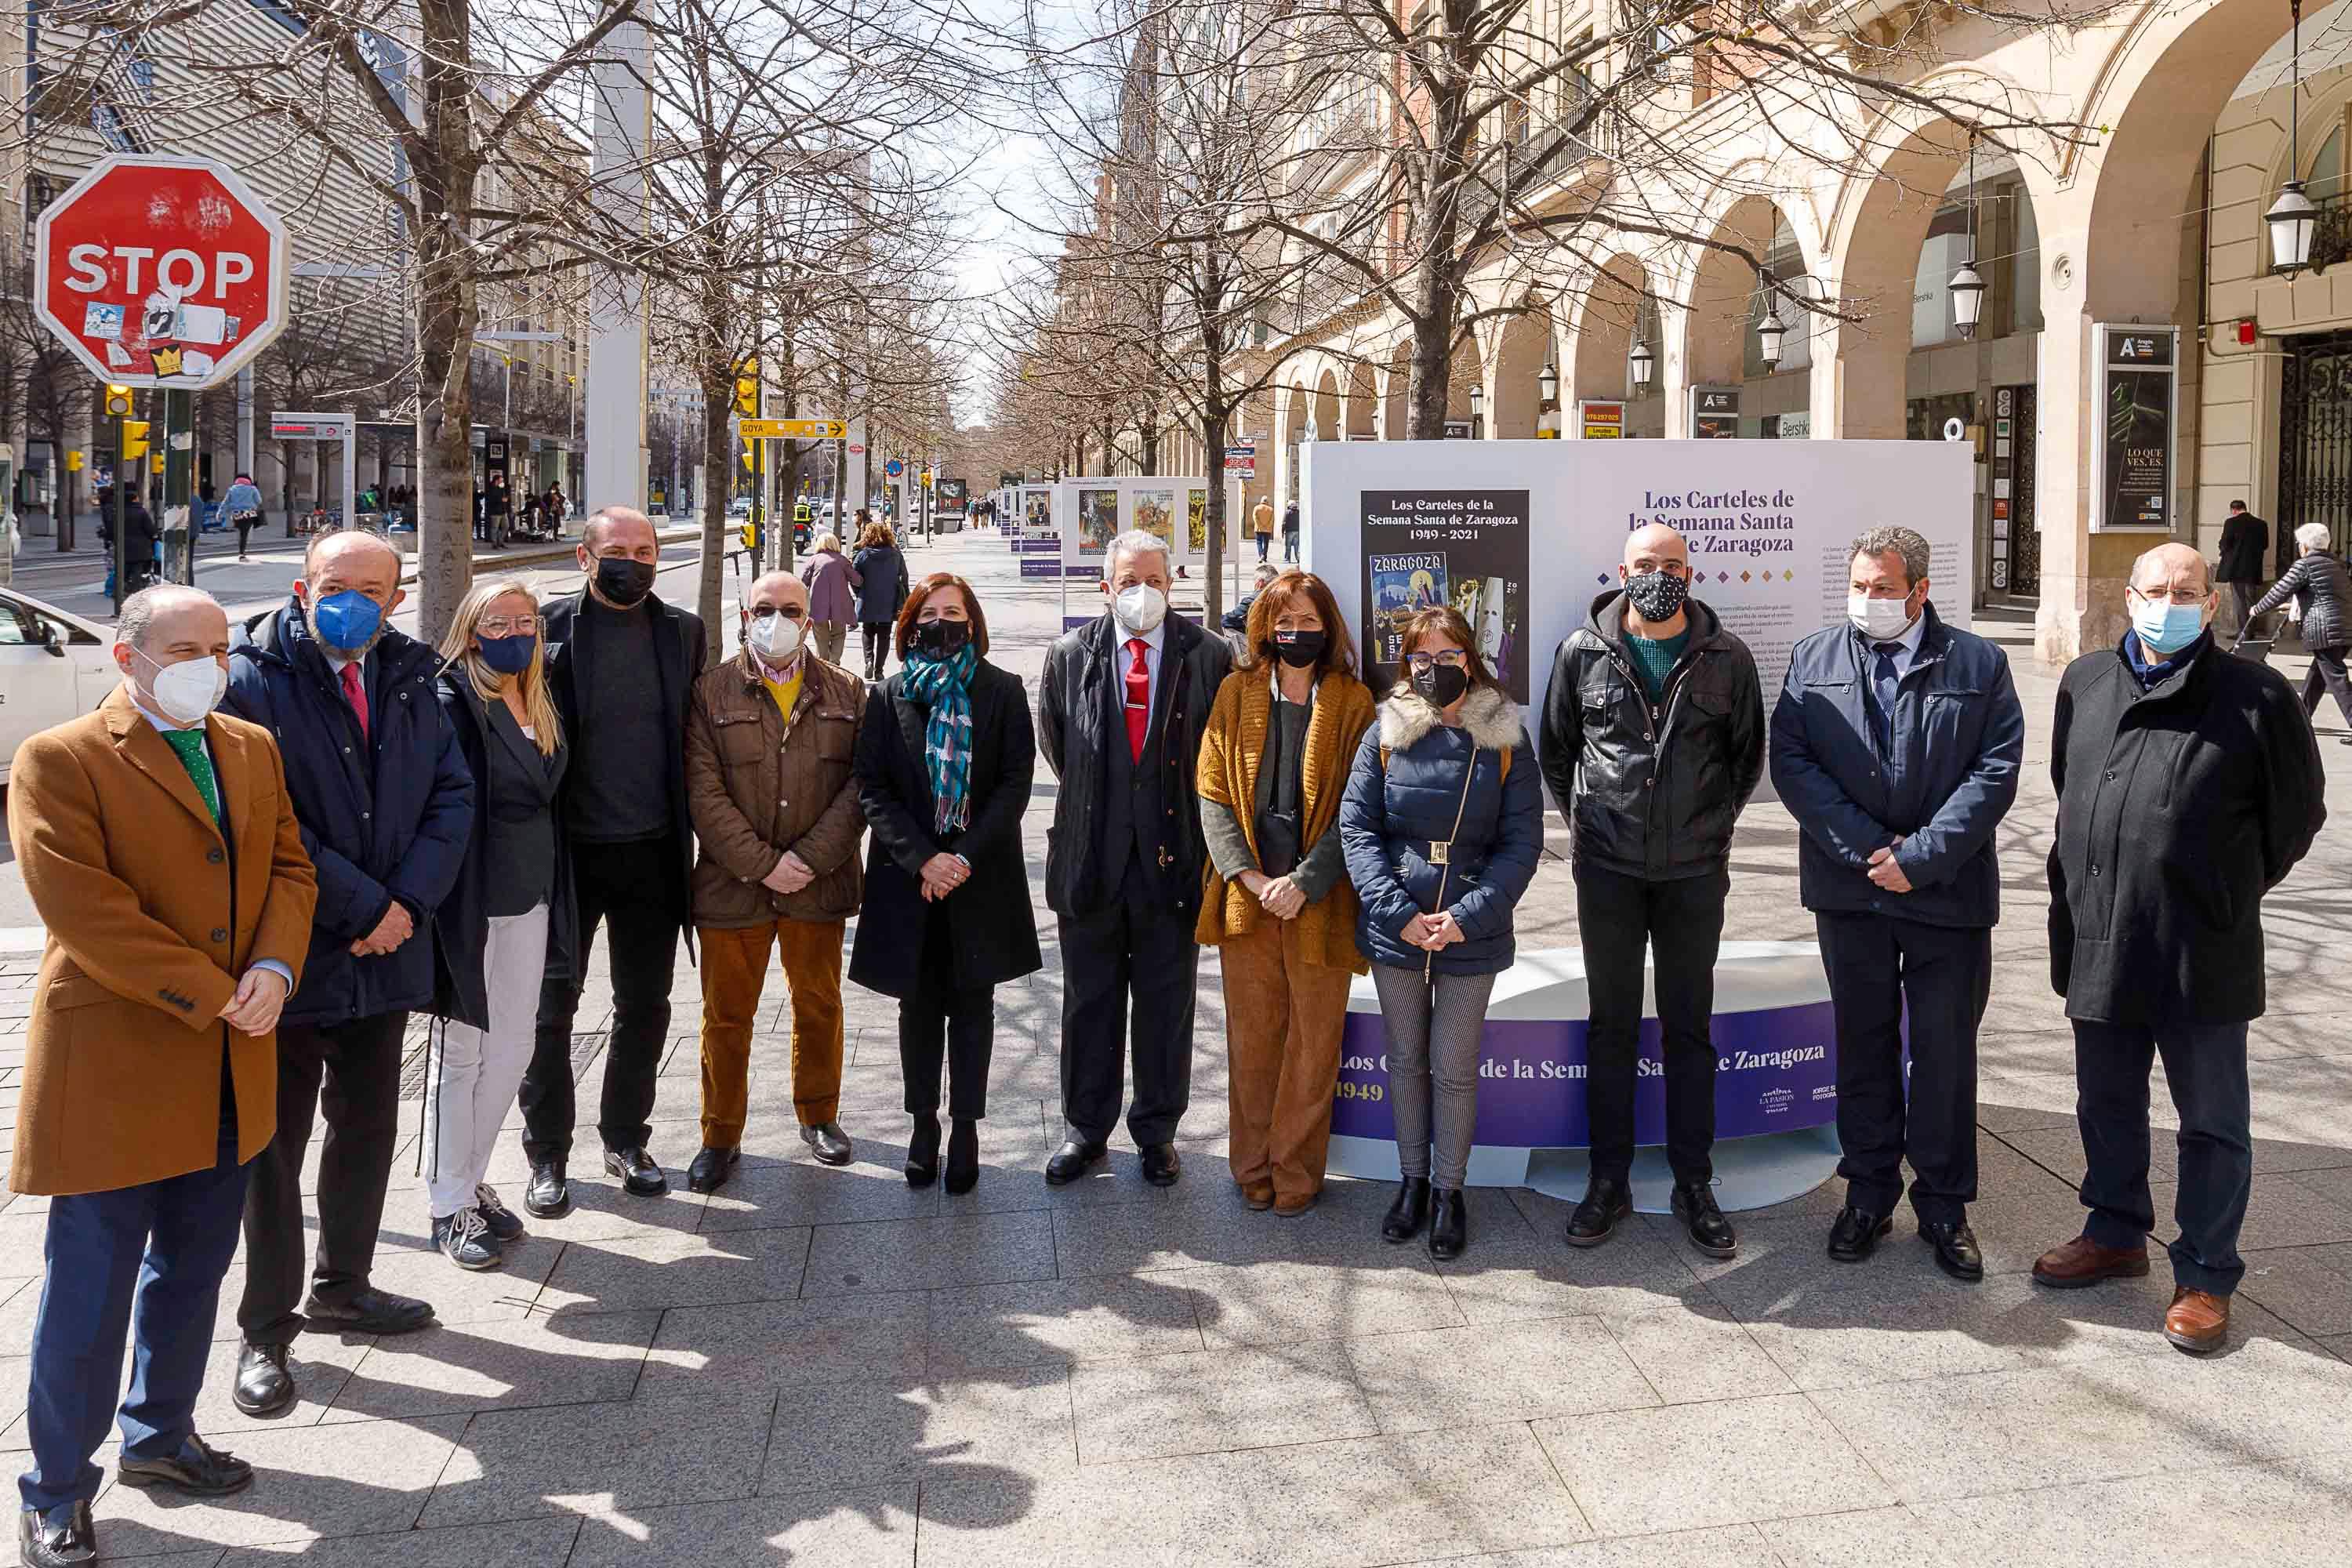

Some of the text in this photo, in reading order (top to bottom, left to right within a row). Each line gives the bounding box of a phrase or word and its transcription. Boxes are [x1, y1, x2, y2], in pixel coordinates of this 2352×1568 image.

[63, 244, 254, 299] STOP
[742, 424, 764, 433] GOYA
[2128, 448, 2163, 458] LO QUE
[1392, 499, 1494, 510] Los Carteles de la
[1645, 489, 1794, 509] Los Carteles de
[1368, 514, 1519, 527] Semana Santa de Zaragoza
[1629, 513, 1647, 532] la
[1740, 513, 1794, 530] Santa
[1410, 529, 1439, 540] 1949
[1450, 529, 1478, 540] 2021
[1682, 535, 1794, 557] e Zaragoza
[1374, 555, 1442, 572] ZARAGOZA
[1339, 1054, 1374, 1071] Los
[1479, 1058, 1508, 1079] de
[1513, 1058, 1534, 1079] la
[1715, 1058, 1730, 1073] e
[1734, 1044, 1825, 1071] Zaragoza
[1335, 1081, 1384, 1102] 1949
